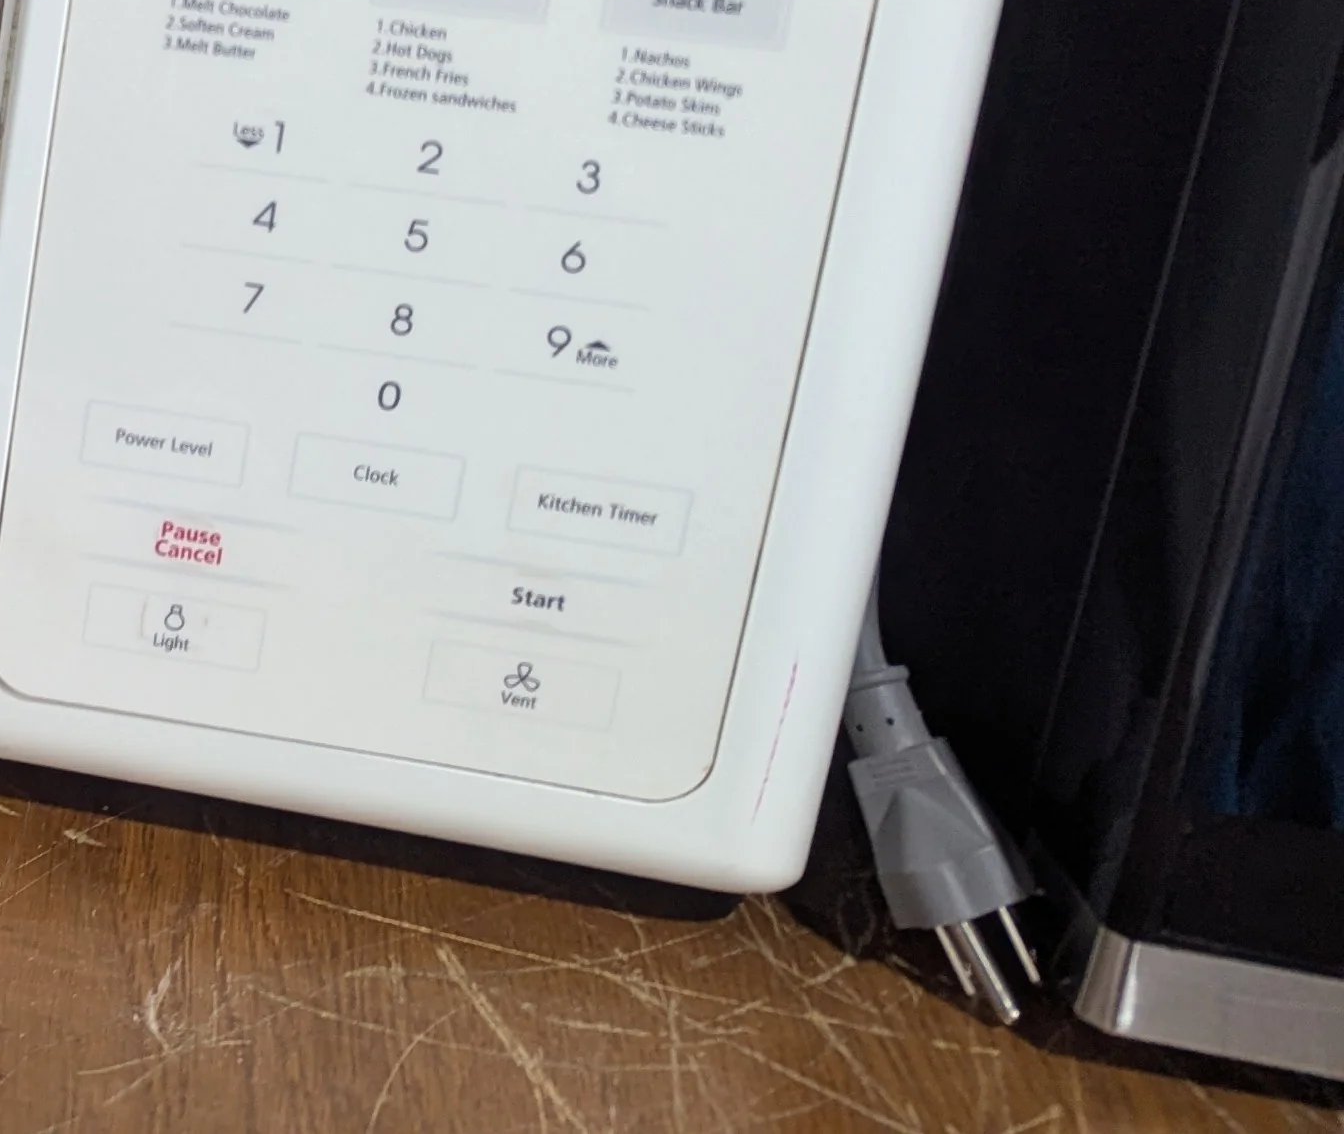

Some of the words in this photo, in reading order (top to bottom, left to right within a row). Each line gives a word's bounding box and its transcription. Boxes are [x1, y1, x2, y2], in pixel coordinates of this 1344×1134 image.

[227, 20, 276, 41] Cream
[416, 43, 453, 66] Dogs
[435, 67, 470, 88] Fries
[431, 91, 517, 114] sandwiches
[232, 121, 265, 142] Less
[274, 120, 286, 155] 1
[416, 139, 444, 176] 2
[575, 159, 601, 195] 3
[252, 200, 278, 233] 4
[403, 219, 429, 254] 5
[560, 240, 587, 275] 6
[242, 281, 265, 315] 7
[389, 303, 414, 337] 8
[546, 325, 573, 358] 9
[575, 347, 619, 369] More
[377, 380, 402, 412] 0
[115, 427, 167, 450] Power
[170, 436, 214, 458] Level
[353, 464, 399, 487] Clock
[537, 493, 604, 518] Kitchen
[609, 502, 658, 526] Timer
[159, 520, 223, 549] Pause
[154, 539, 223, 566] Cancel
[511, 586, 566, 613] Start
[152, 631, 190, 653] Light
[500, 691, 538, 710] Vent
